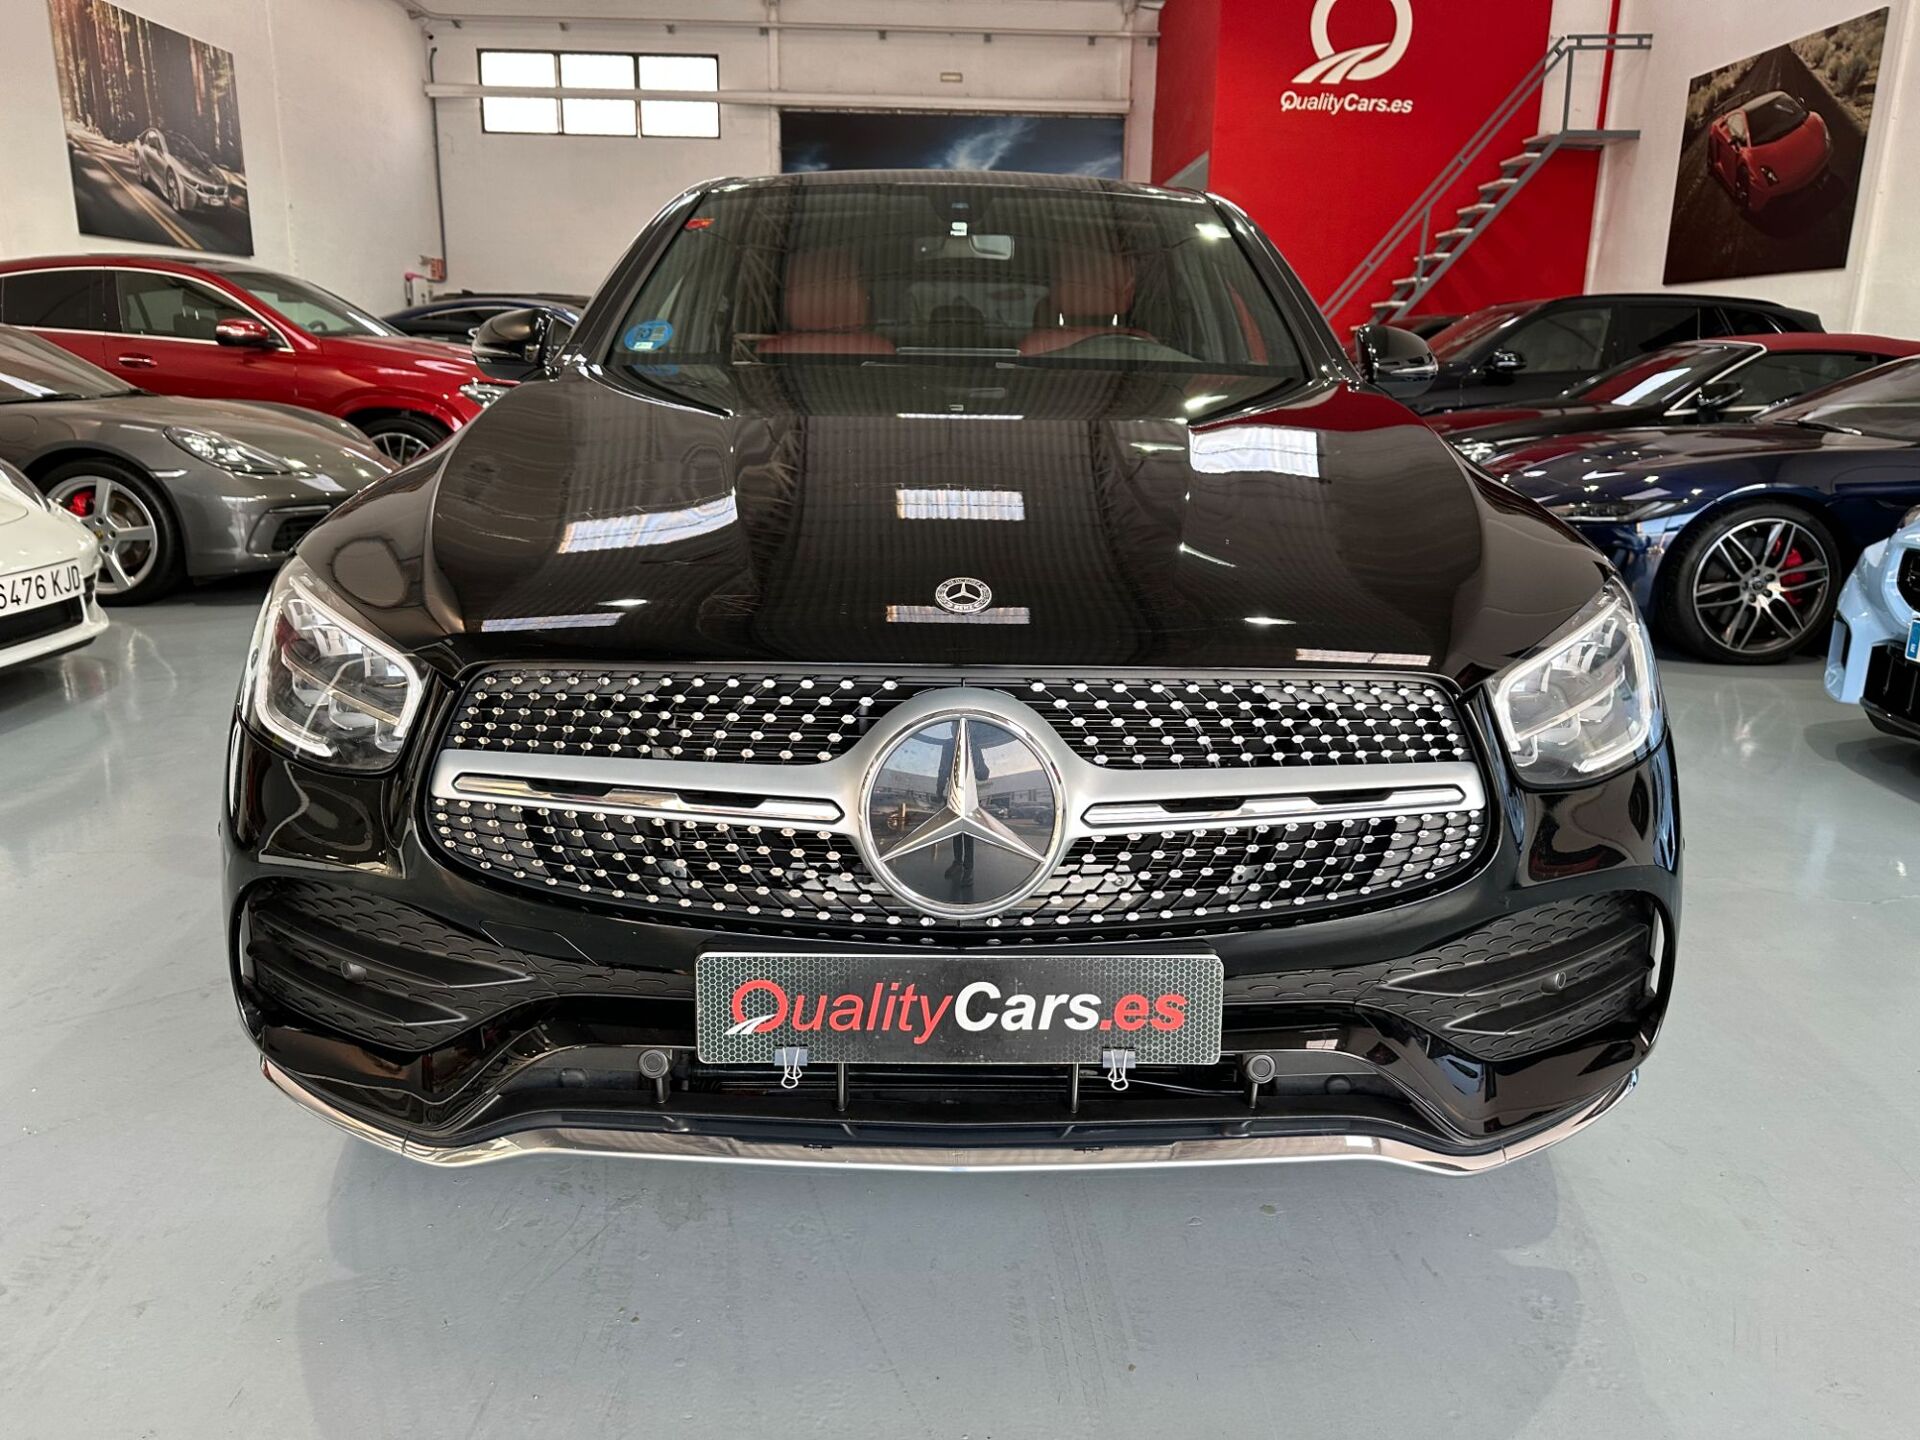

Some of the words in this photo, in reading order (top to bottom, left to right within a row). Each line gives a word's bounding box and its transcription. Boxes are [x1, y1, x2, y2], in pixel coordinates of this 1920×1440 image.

[1280, 90, 1414, 116] QualityCars.es
[50, 565, 81, 596] KJD
[725, 979, 1189, 1044] QualityCars.es
